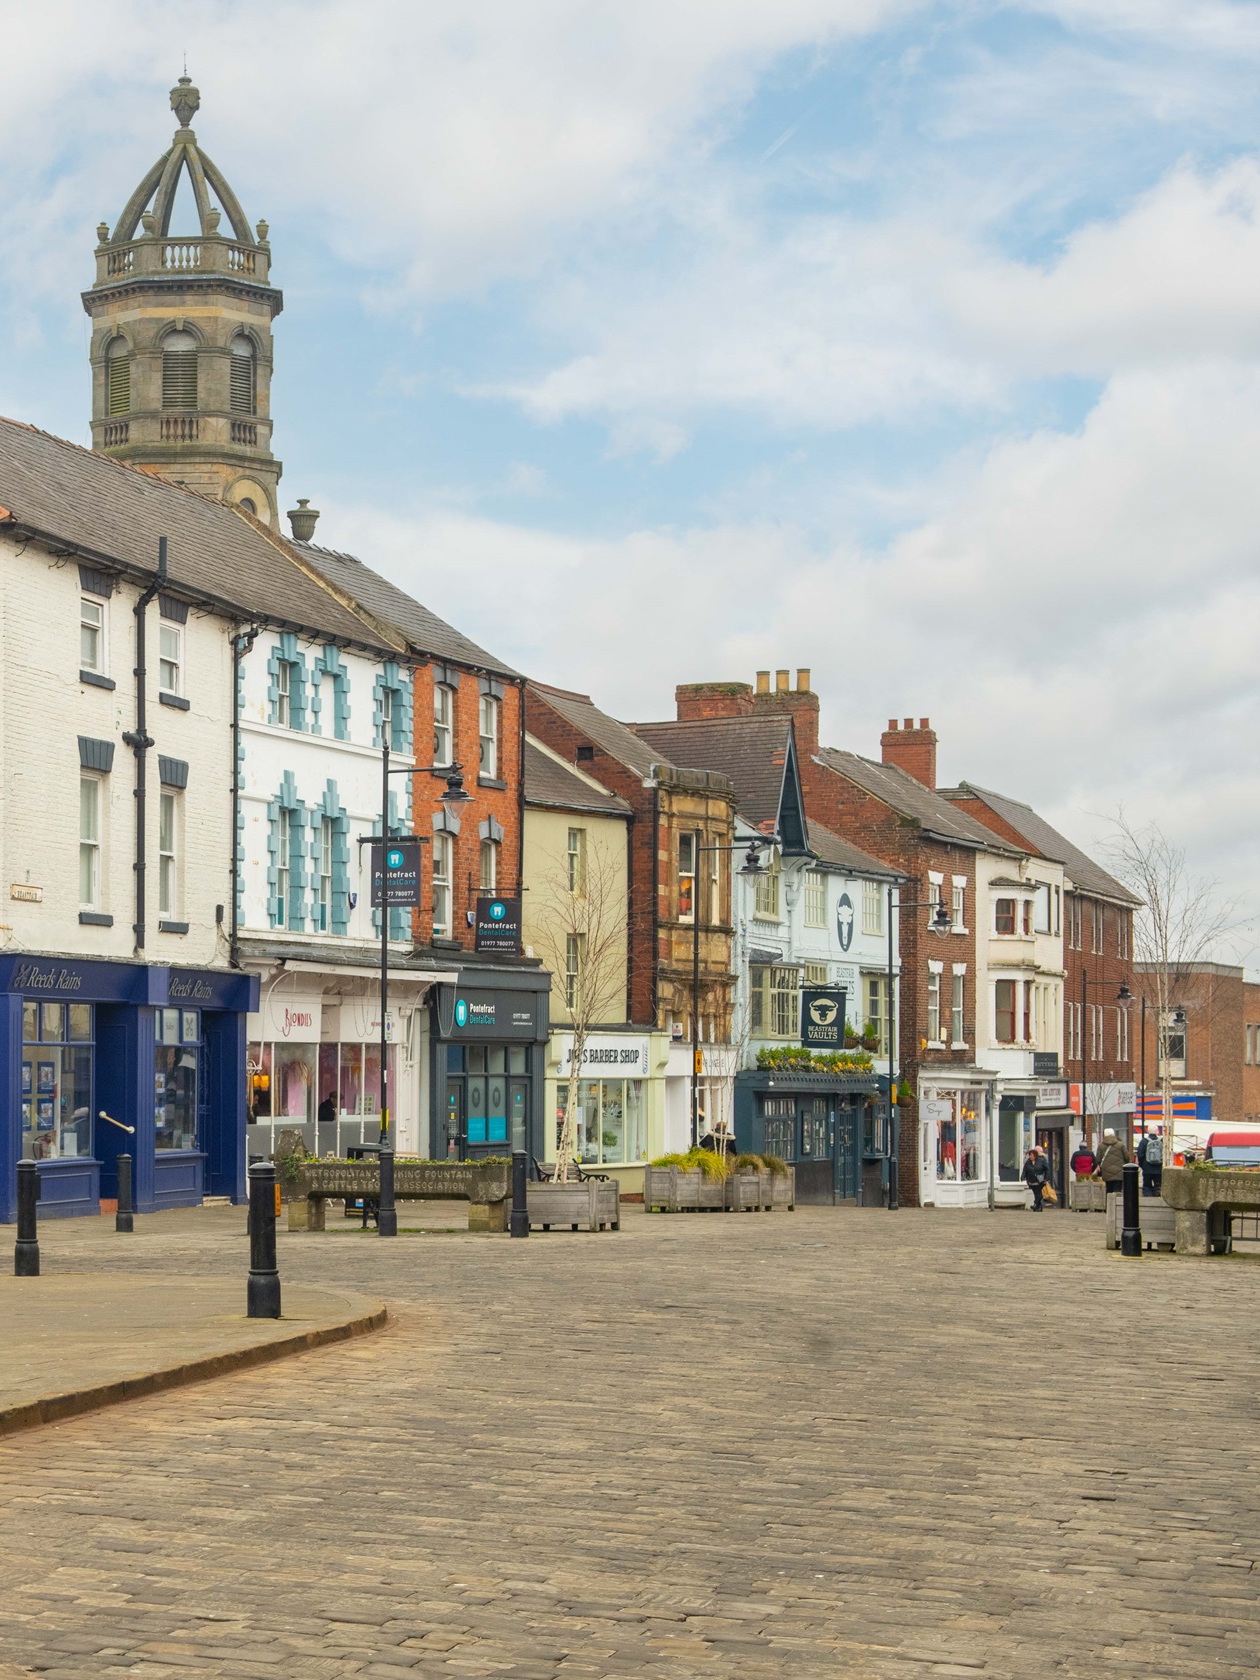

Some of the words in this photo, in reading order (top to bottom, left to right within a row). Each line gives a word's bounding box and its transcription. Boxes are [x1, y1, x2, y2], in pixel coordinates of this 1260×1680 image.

[26, 967, 56, 988] Reeds
[55, 970, 82, 990] Rains
[169, 978, 191, 997] Reeds
[190, 980, 214, 999] Rains
[470, 1004, 495, 1013] Pontefract
[470, 1015, 495, 1024] DentalCare
[589, 1049, 618, 1063] BARBER
[620, 1050, 640, 1063] SHOP
[305, 1169, 371, 1178] METROPOLITAN
[424, 1170, 473, 1178] FOUNTAIN
[311, 1180, 318, 1188] &
[322, 1180, 358, 1188] CATTLE
[363, 1180, 400, 1189] TROH
